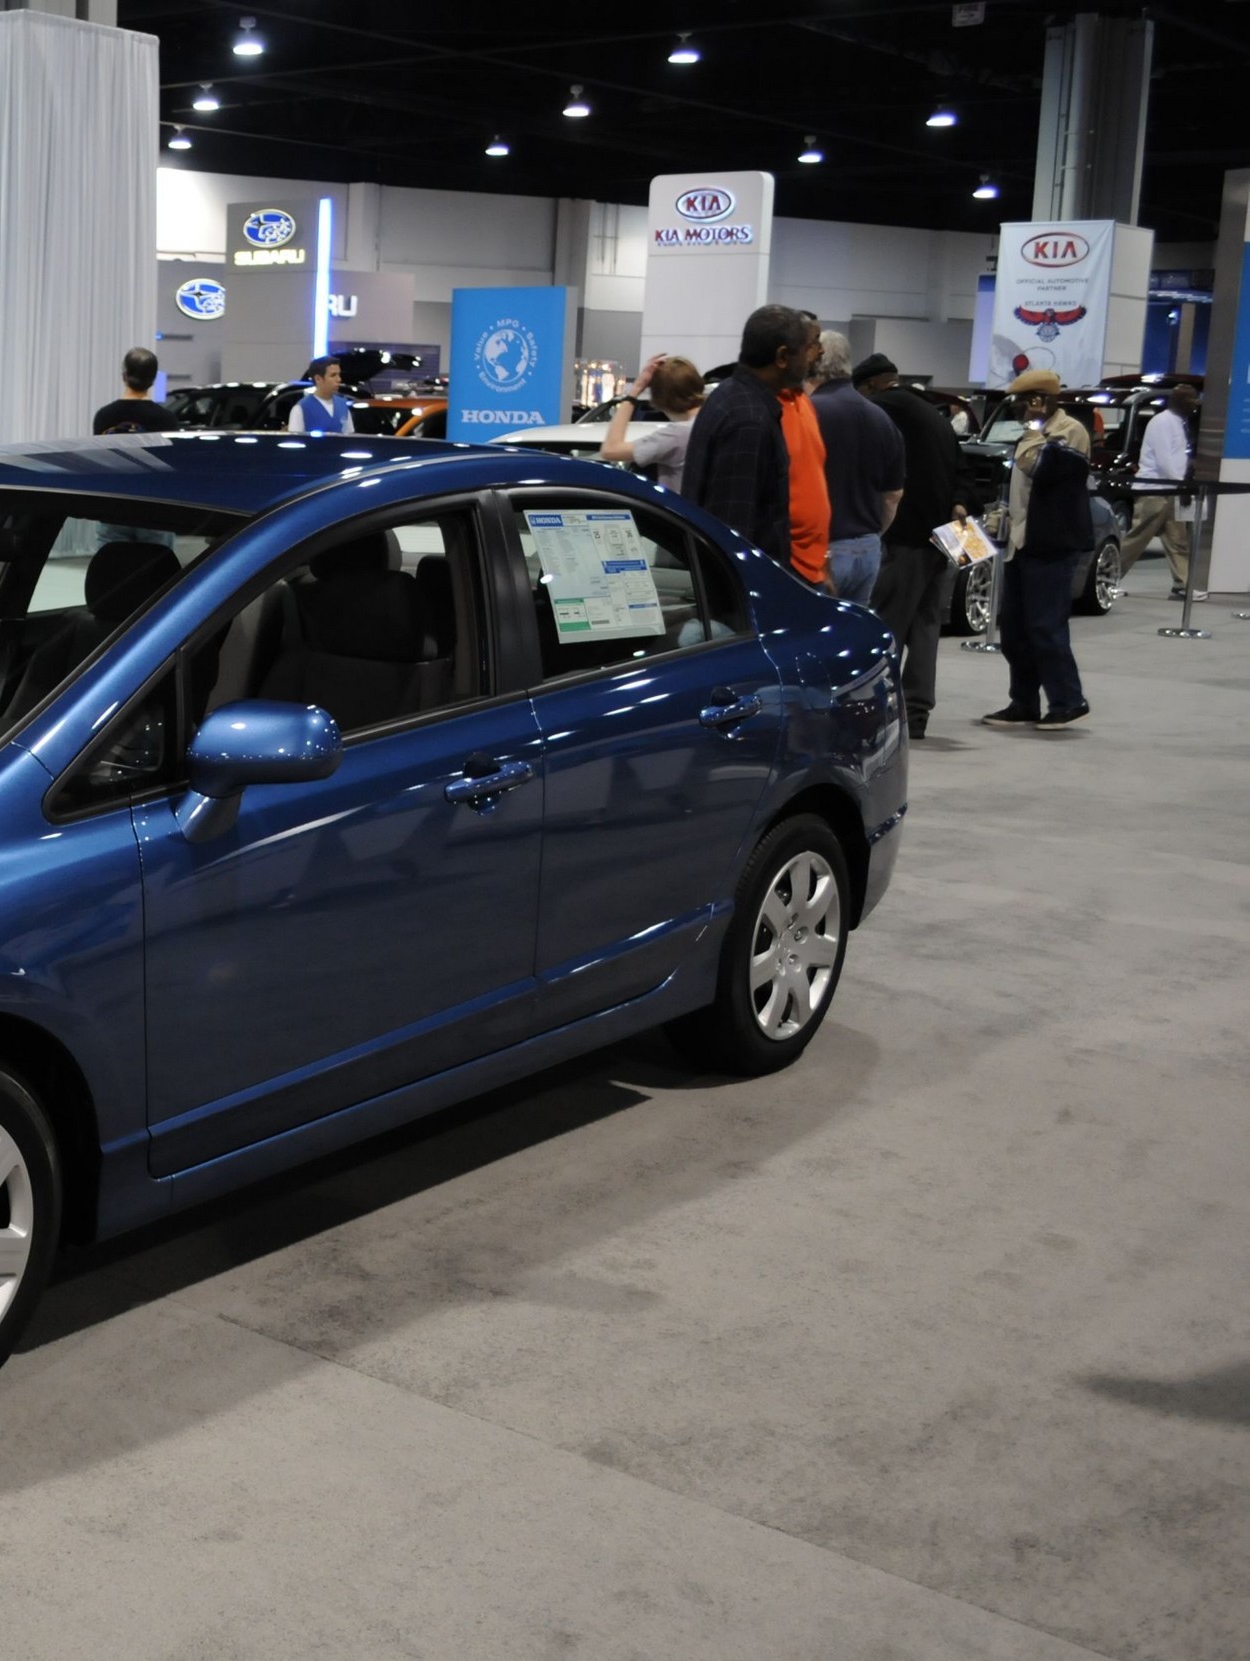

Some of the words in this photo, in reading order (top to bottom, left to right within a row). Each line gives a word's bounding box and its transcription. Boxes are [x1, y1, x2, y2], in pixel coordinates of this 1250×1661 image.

[685, 195, 722, 212] KIA
[654, 227, 681, 243] KIA
[684, 225, 751, 243] MOTORS
[233, 248, 306, 266] SUBARU
[1033, 240, 1078, 259] KIA
[496, 319, 520, 328] MPG
[474, 331, 489, 361] Value
[526, 331, 538, 368] Safety
[478, 371, 527, 393] Environment
[461, 409, 546, 425] HONDA
[535, 516, 562, 525] HONDA
